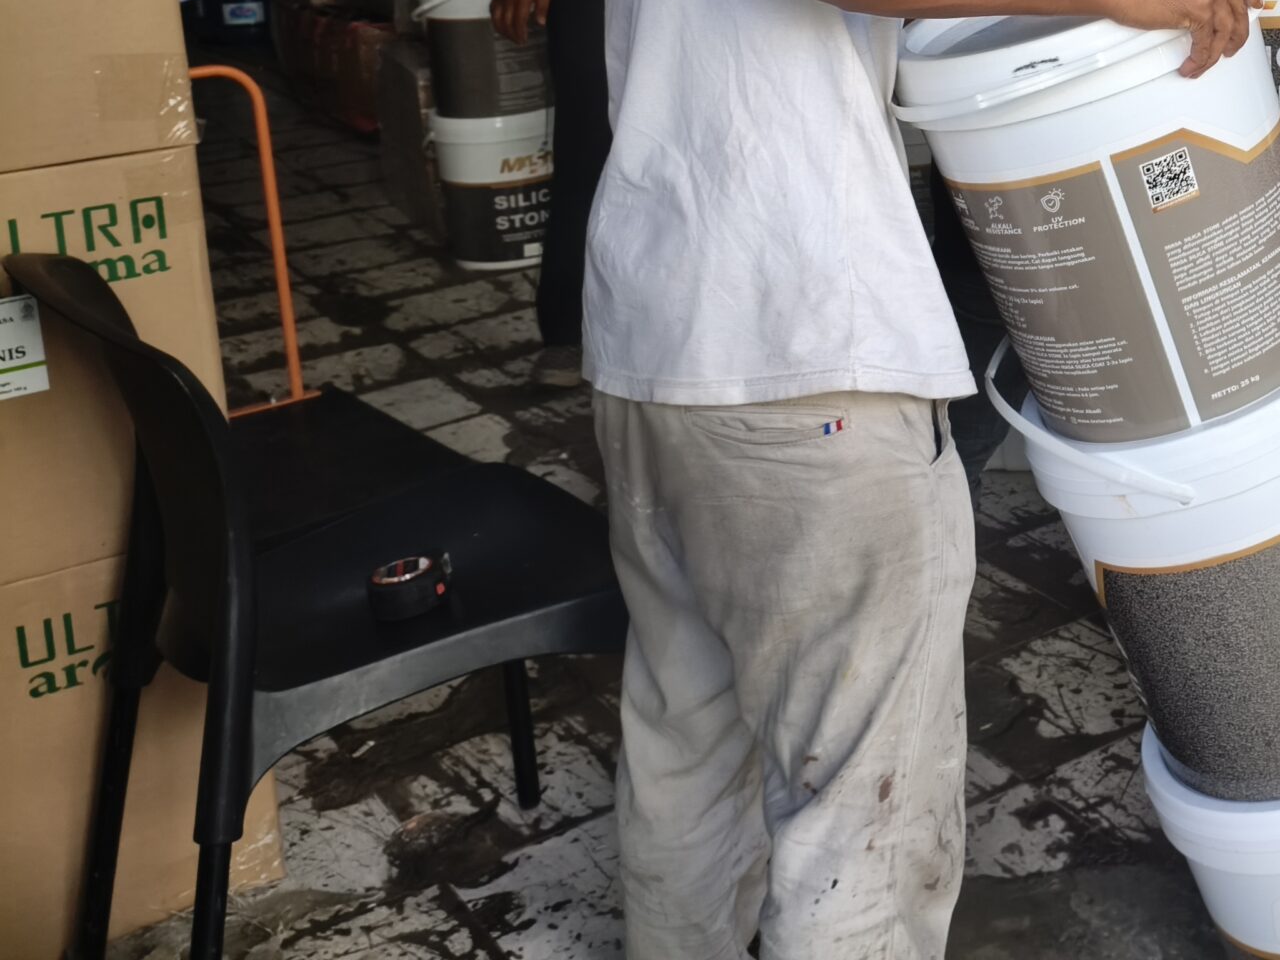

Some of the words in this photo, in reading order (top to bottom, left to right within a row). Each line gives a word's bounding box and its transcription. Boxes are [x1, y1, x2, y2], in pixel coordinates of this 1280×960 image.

[494, 189, 550, 210] SILIC
[496, 211, 549, 230] STON
[1033, 217, 1086, 232] PROTECTION
[1051, 216, 1064, 224] UV
[1181, 284, 1219, 304] INFORMASI
[1183, 301, 1200, 311] DAN
[1200, 282, 1242, 304] LINGKUNGAN
[1211, 384, 1240, 400] NETTO:
[1240, 379, 1250, 388] 25
[1250, 374, 1261, 383] kg
